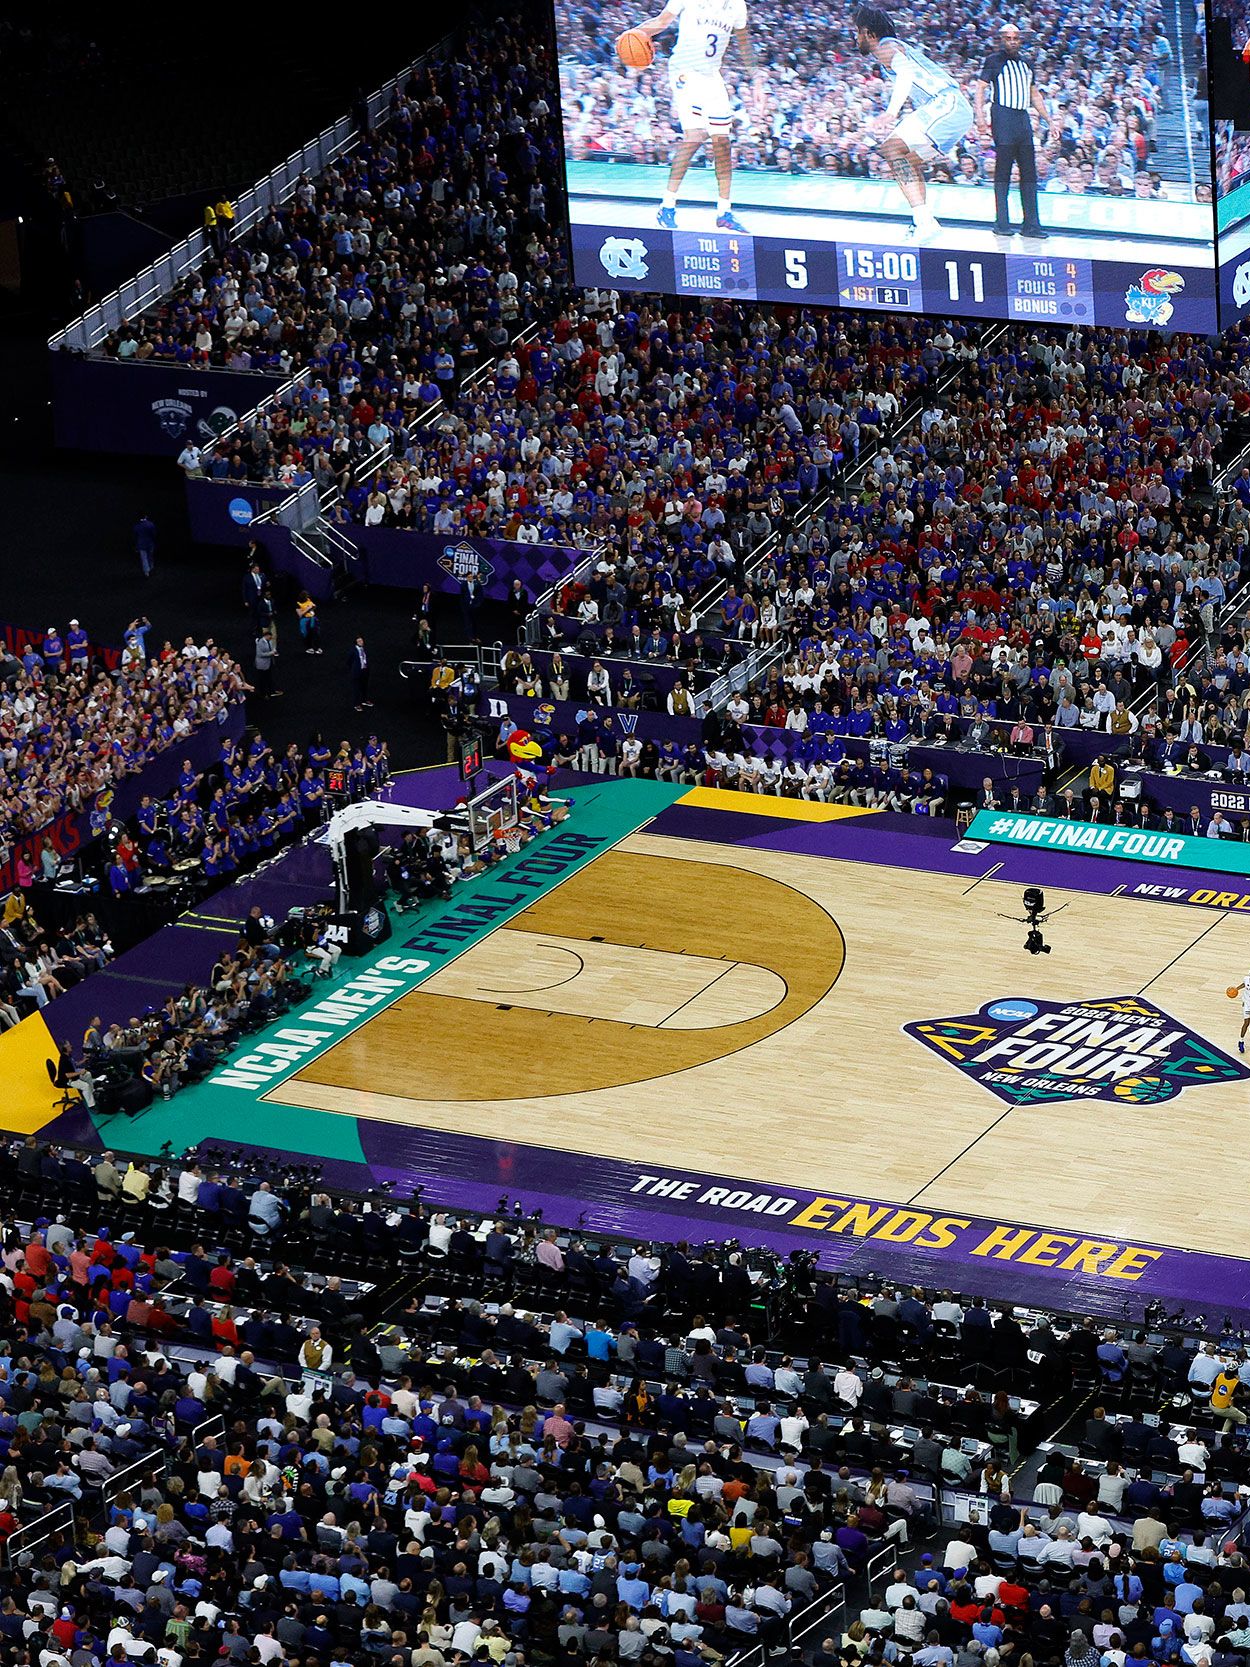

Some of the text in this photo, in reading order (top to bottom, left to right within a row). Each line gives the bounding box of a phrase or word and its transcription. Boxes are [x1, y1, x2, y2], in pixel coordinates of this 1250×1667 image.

[705, 33, 718, 58] 3
[698, 238, 739, 254] TOL 4
[684, 255, 740, 273] FOULS 3
[784, 249, 809, 290] 5
[843, 248, 918, 282] 15:00
[1033, 261, 1077, 279] TOL 4
[681, 273, 722, 290] BONUS
[945, 260, 985, 303] 11
[1017, 279, 1076, 297] FOULS 0
[884, 289, 900, 304] 21
[1014, 298, 1058, 315] BONUS
[453, 551, 480, 566] FINAL
[453, 562, 479, 576] FOUR
[617, 713, 639, 735] V
[1210, 792, 1246, 809] 2022
[988, 816, 1186, 861] #MFINALFOUR
[1133, 883, 1188, 899] NEW
[207, 832, 609, 1092] NCAA MEN'S FINAL FOUR
[991, 1007, 1034, 1019] NCAA
[1059, 1006, 1167, 1028] 2022 MEN'S
[1012, 1012, 1187, 1058] FINAL
[972, 1036, 1155, 1081] FOUR
[980, 1071, 1103, 1097] NEW ORLEANS
[630, 1174, 1165, 1282] THE ROAD ENDS HERE
